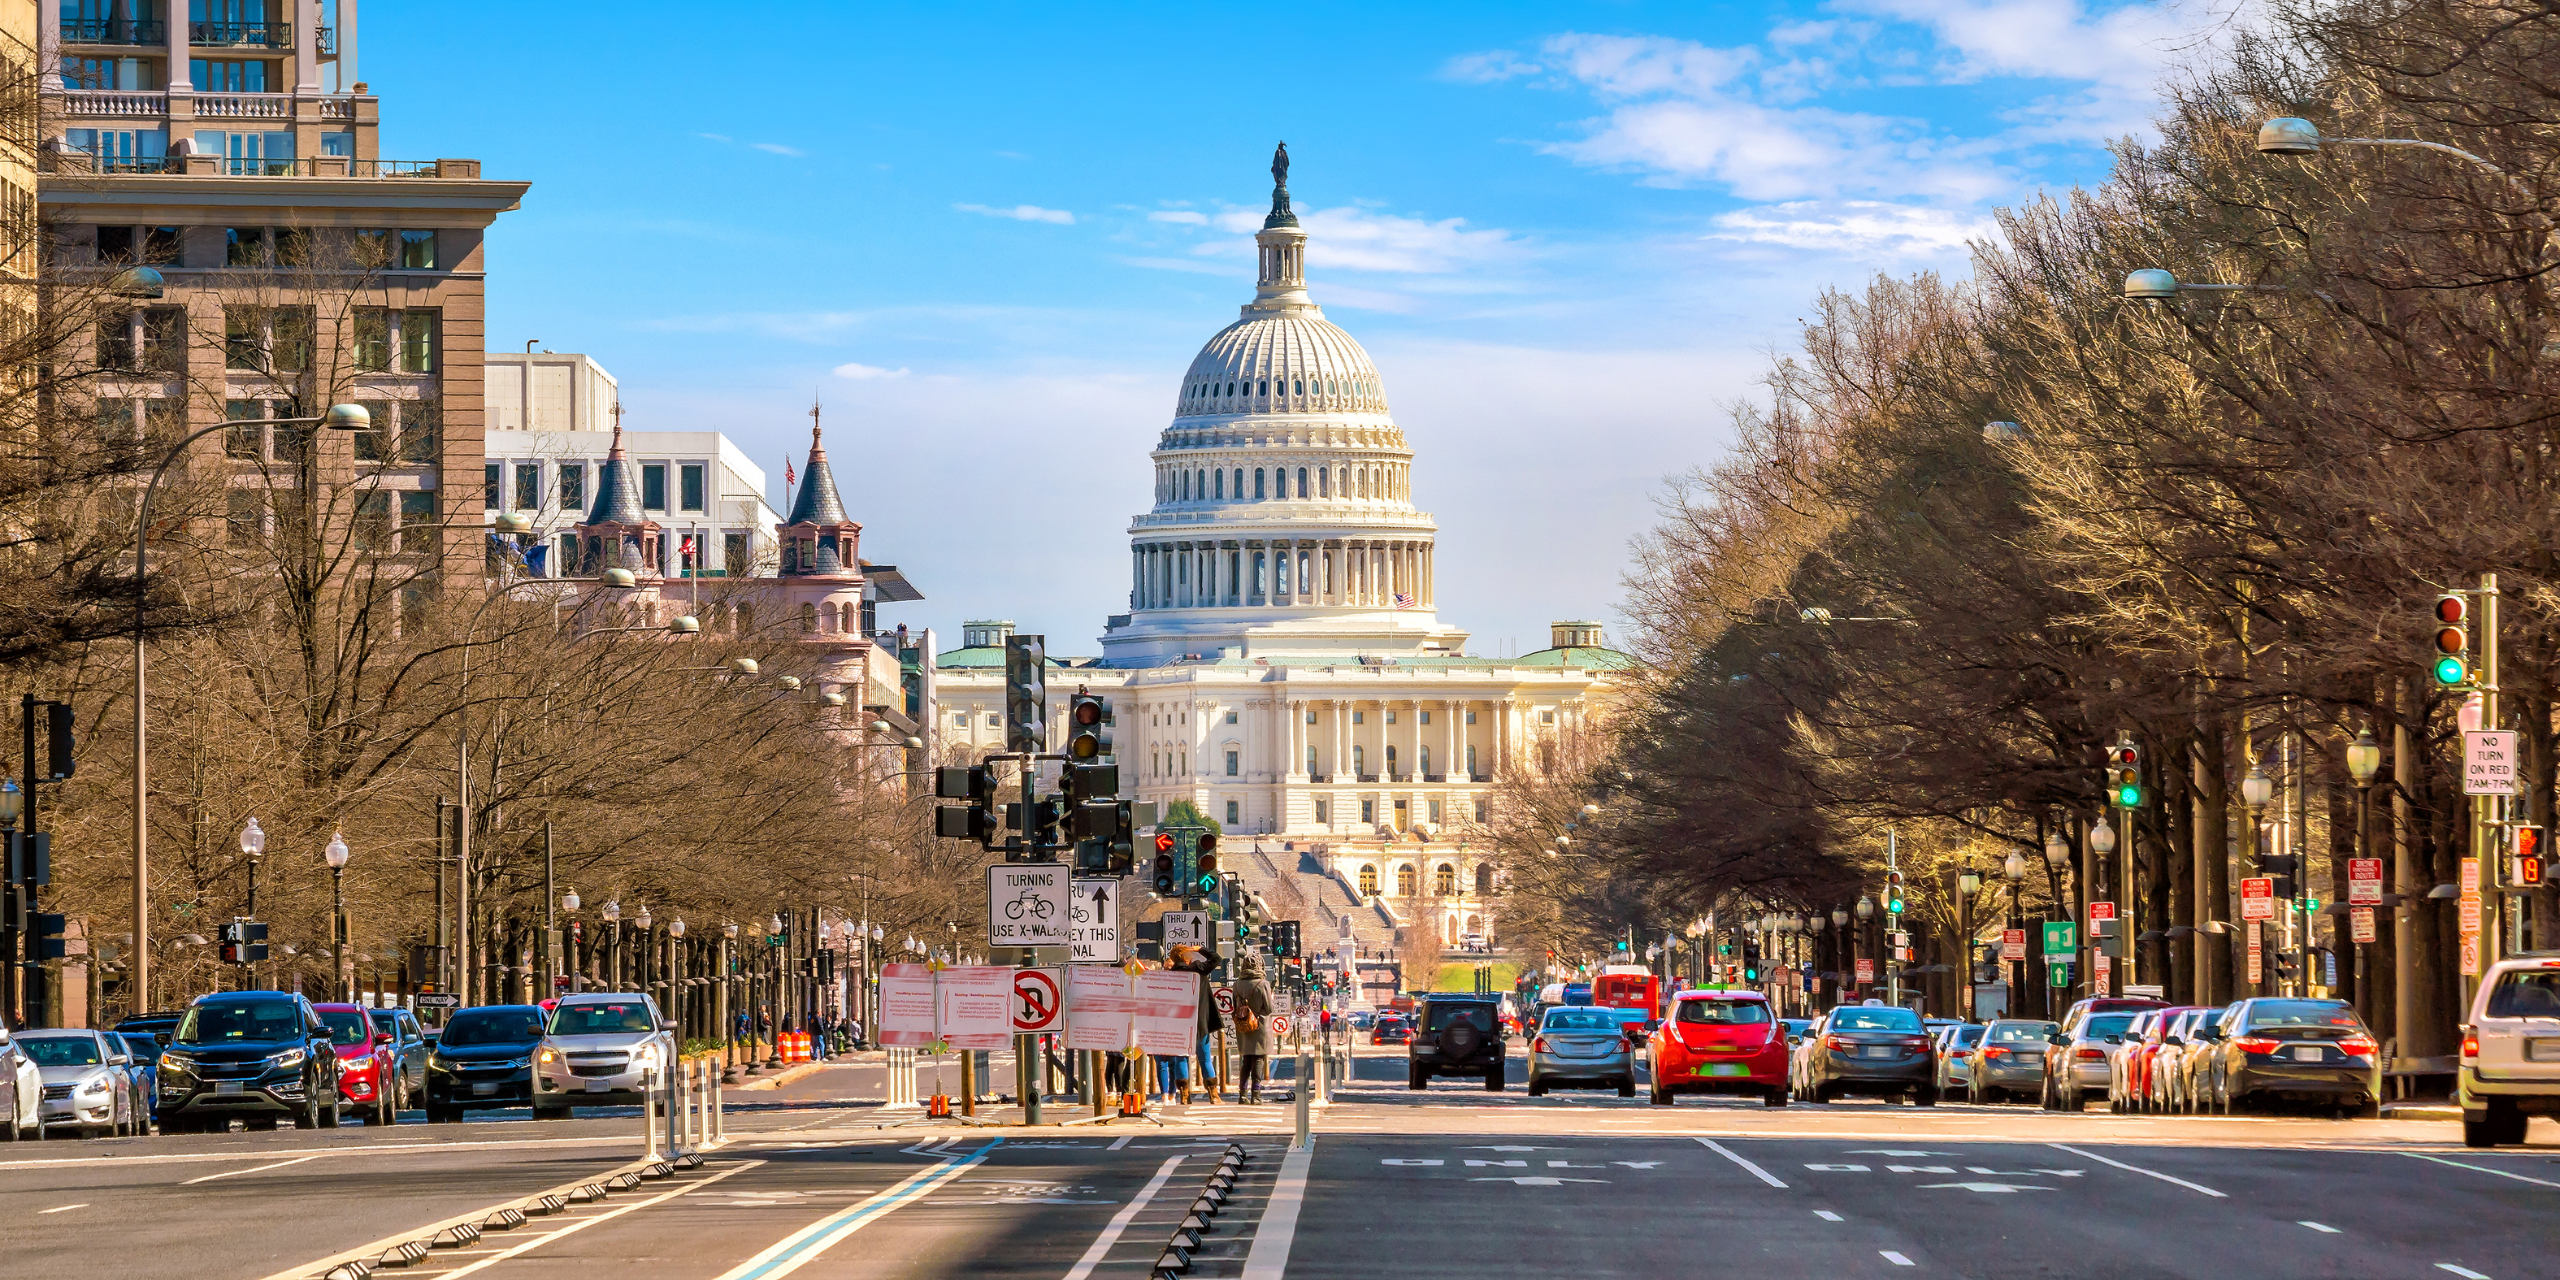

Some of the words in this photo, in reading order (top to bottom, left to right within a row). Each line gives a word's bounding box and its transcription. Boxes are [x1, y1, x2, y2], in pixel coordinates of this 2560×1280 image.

[2482, 737, 2498, 747] NO
[2477, 751, 2504, 761] TURN
[2470, 764, 2485, 775] ON
[2489, 765, 2510, 775] RED
[1006, 874, 1054, 887] TURNING
[1166, 914, 1187, 924] THRU
[993, 924, 1015, 937] USE
[1090, 928, 1115, 941] THIS
[1381, 1158, 1666, 1170] ONLY
[1803, 1163, 2086, 1178] ONLY
